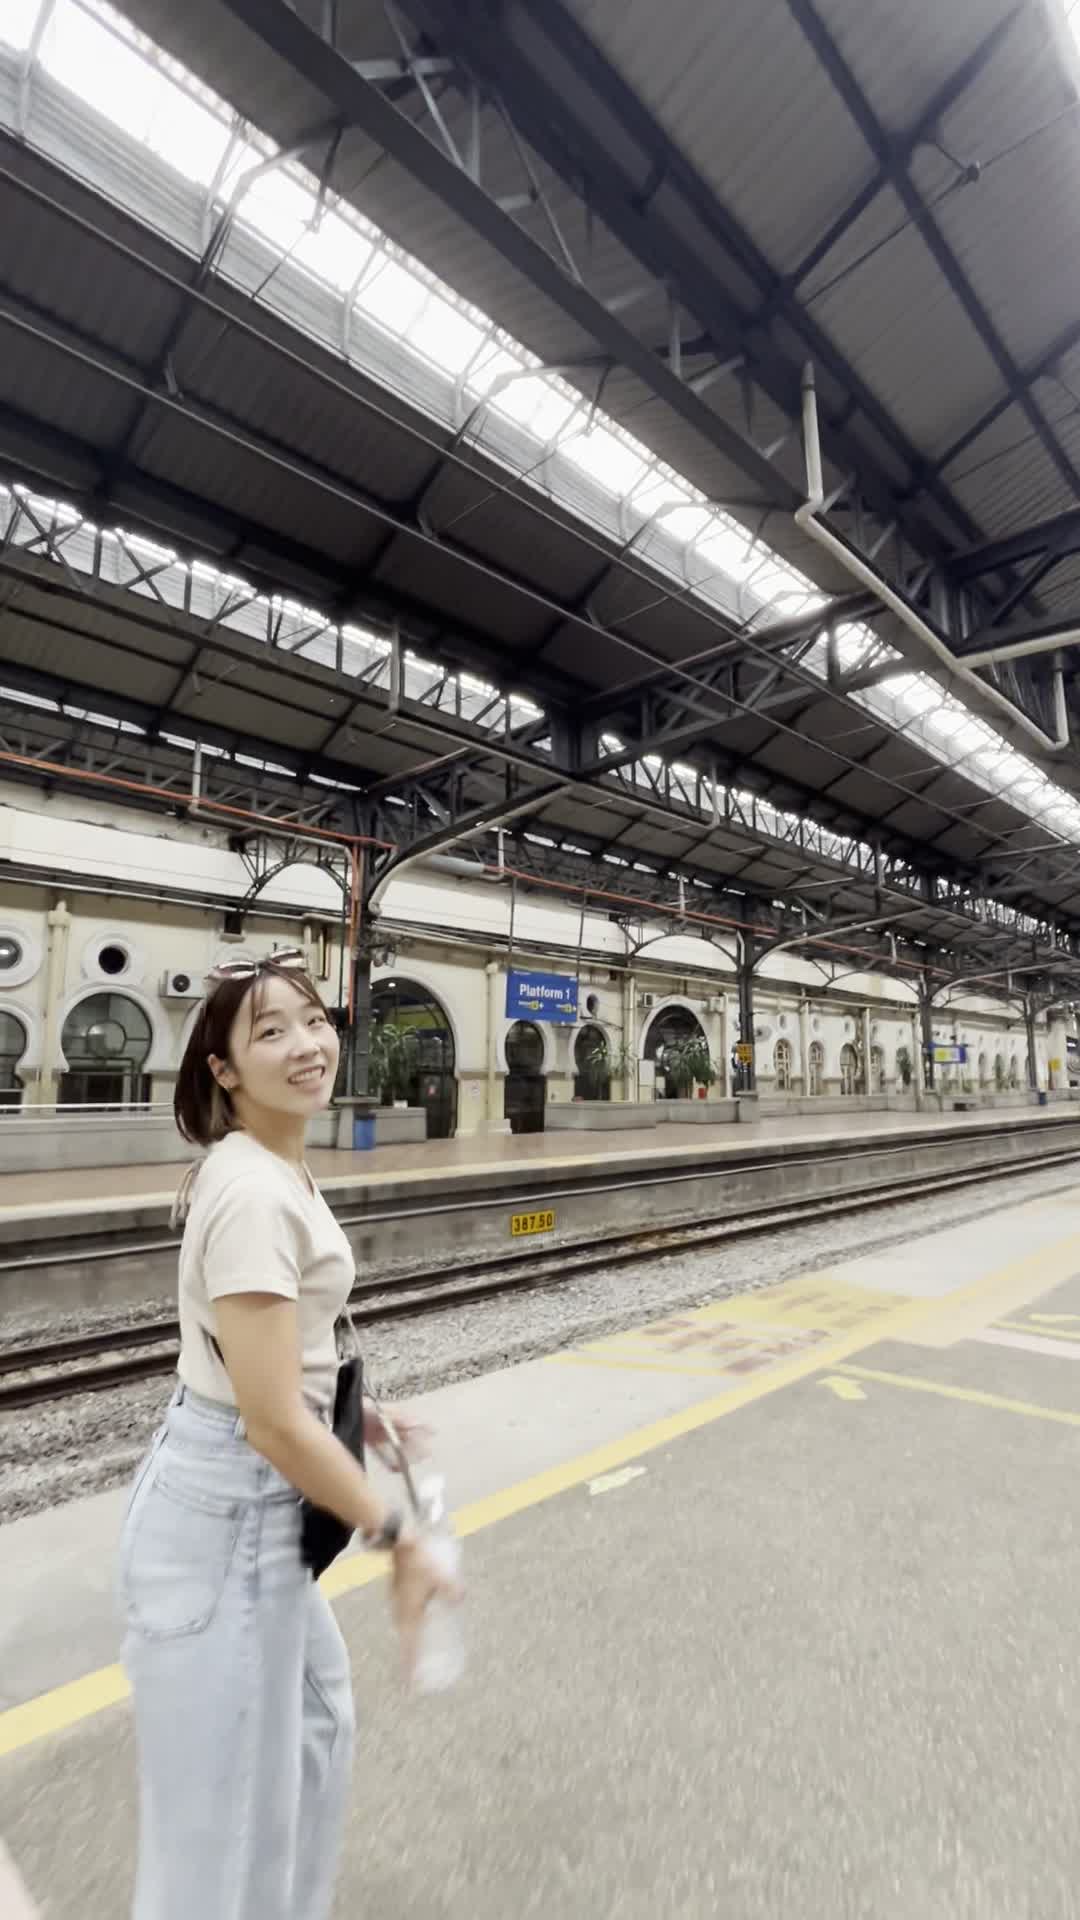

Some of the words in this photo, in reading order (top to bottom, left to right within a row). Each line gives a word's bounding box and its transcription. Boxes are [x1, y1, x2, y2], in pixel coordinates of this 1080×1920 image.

[519, 983, 563, 1000] Platform
[565, 987, 571, 1000] 1
[513, 1212, 553, 1233] 387.50
